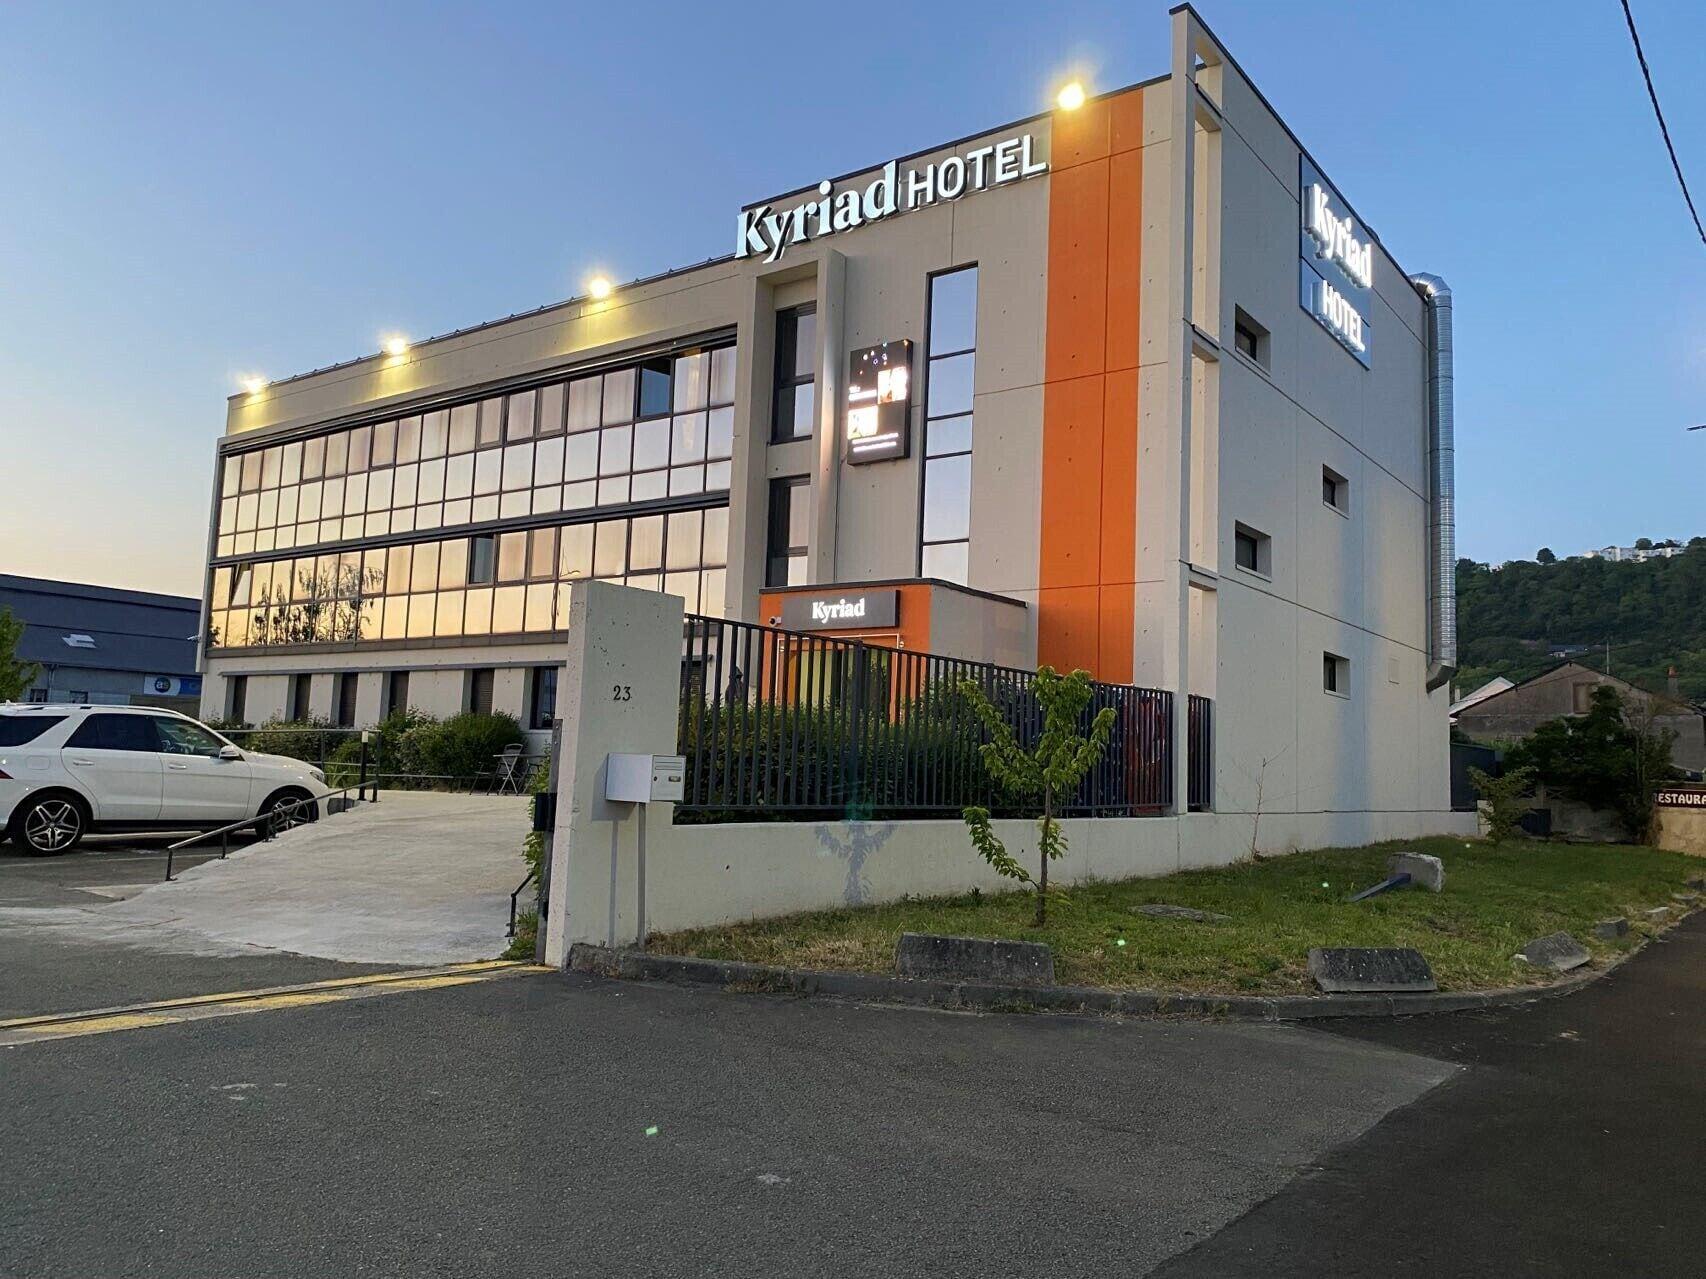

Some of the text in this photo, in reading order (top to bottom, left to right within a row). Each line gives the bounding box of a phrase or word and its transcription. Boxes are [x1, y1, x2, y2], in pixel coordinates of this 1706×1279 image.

[735, 134, 1048, 264] Kyriad HOTEL
[1307, 183, 1372, 288] Kyriad
[1316, 280, 1366, 352] HOTEL
[812, 598, 865, 624] Kyriad
[613, 685, 632, 701] 23
